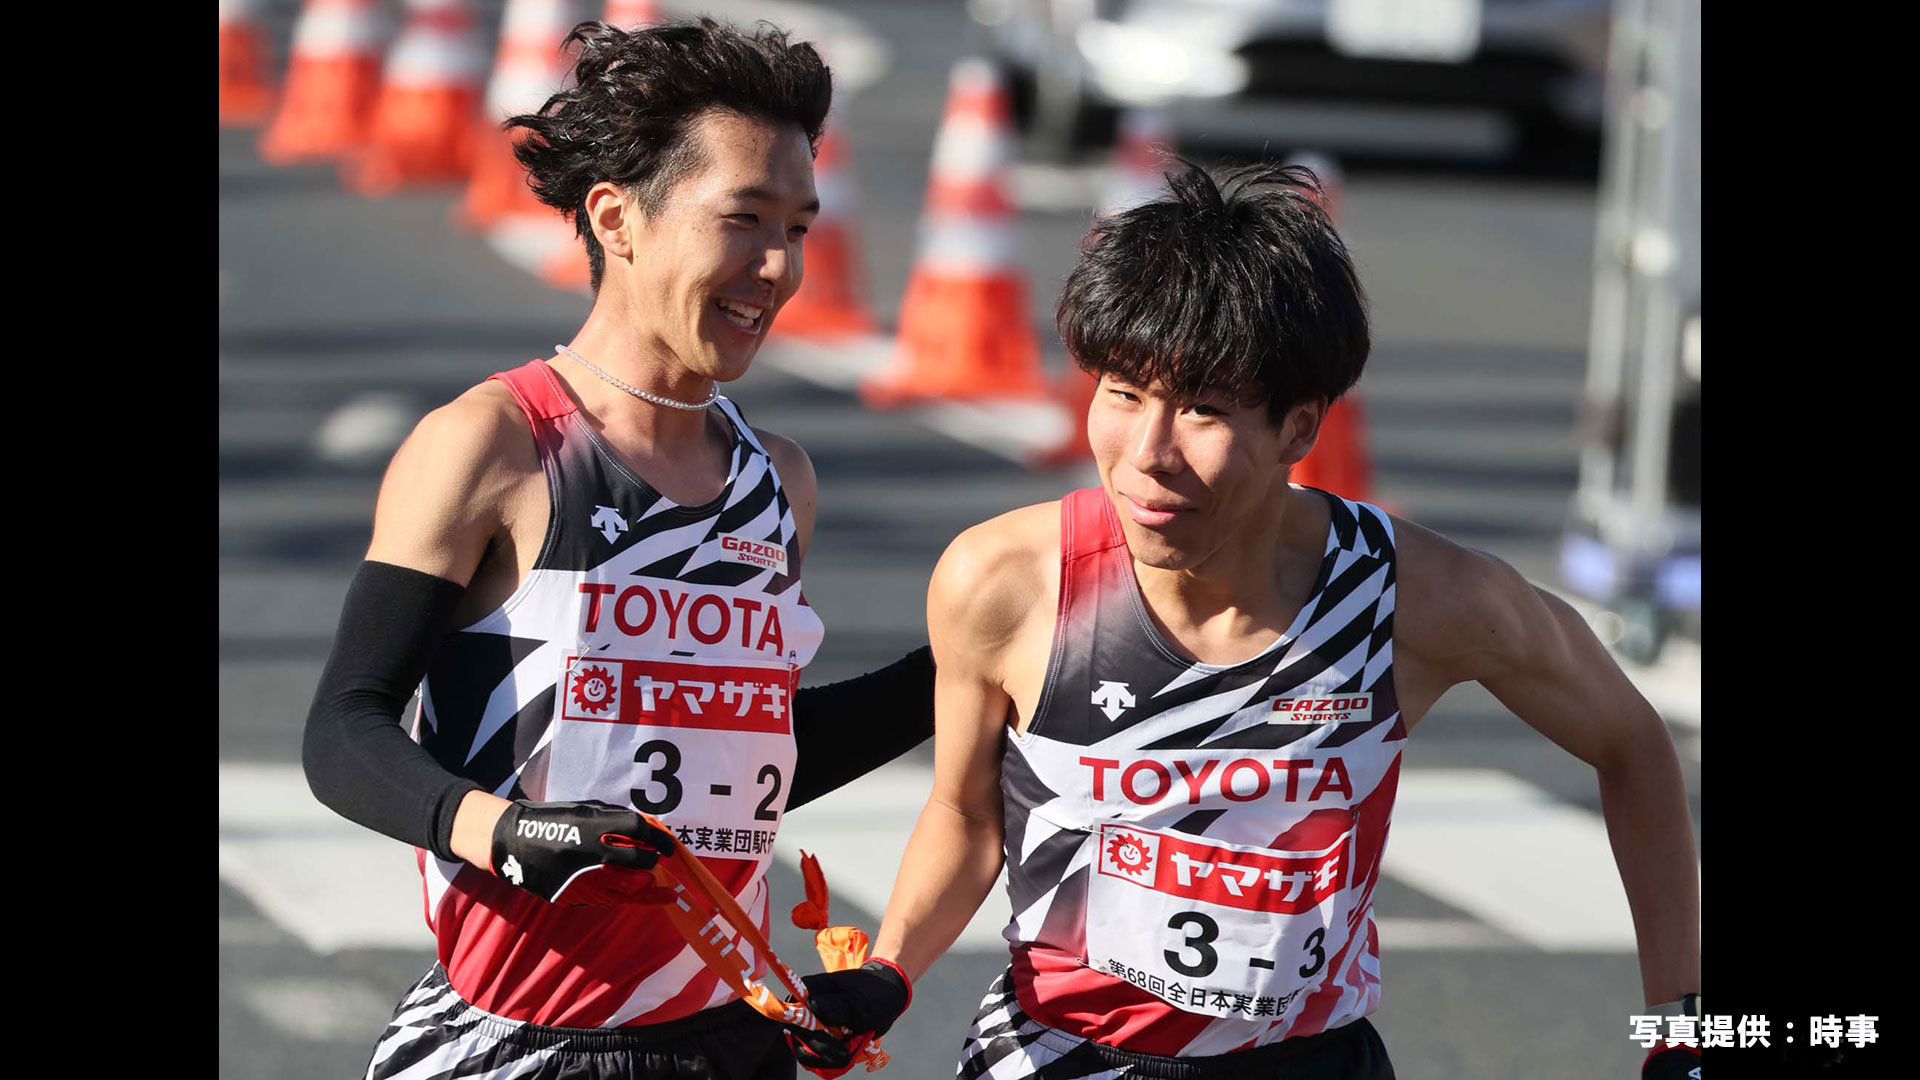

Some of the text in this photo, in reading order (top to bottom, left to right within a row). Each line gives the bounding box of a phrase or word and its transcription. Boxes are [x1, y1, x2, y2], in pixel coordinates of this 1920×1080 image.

[722, 536, 785, 562] GAZOO
[738, 553, 777, 568] SPORTS
[579, 583, 784, 656] TOYOTA
[633, 675, 787, 719] ヤマザキ
[1272, 698, 1369, 712] GAZOO
[1291, 713, 1351, 721] SPORTS
[630, 740, 683, 815] 3
[754, 764, 782, 821] 2
[1079, 756, 1353, 805] TOYOTA
[516, 819, 582, 845] TOYOTA
[1170, 851, 1340, 902] ヤマザキ
[1163, 911, 1219, 978] 3
[1299, 927, 1326, 979] 3
